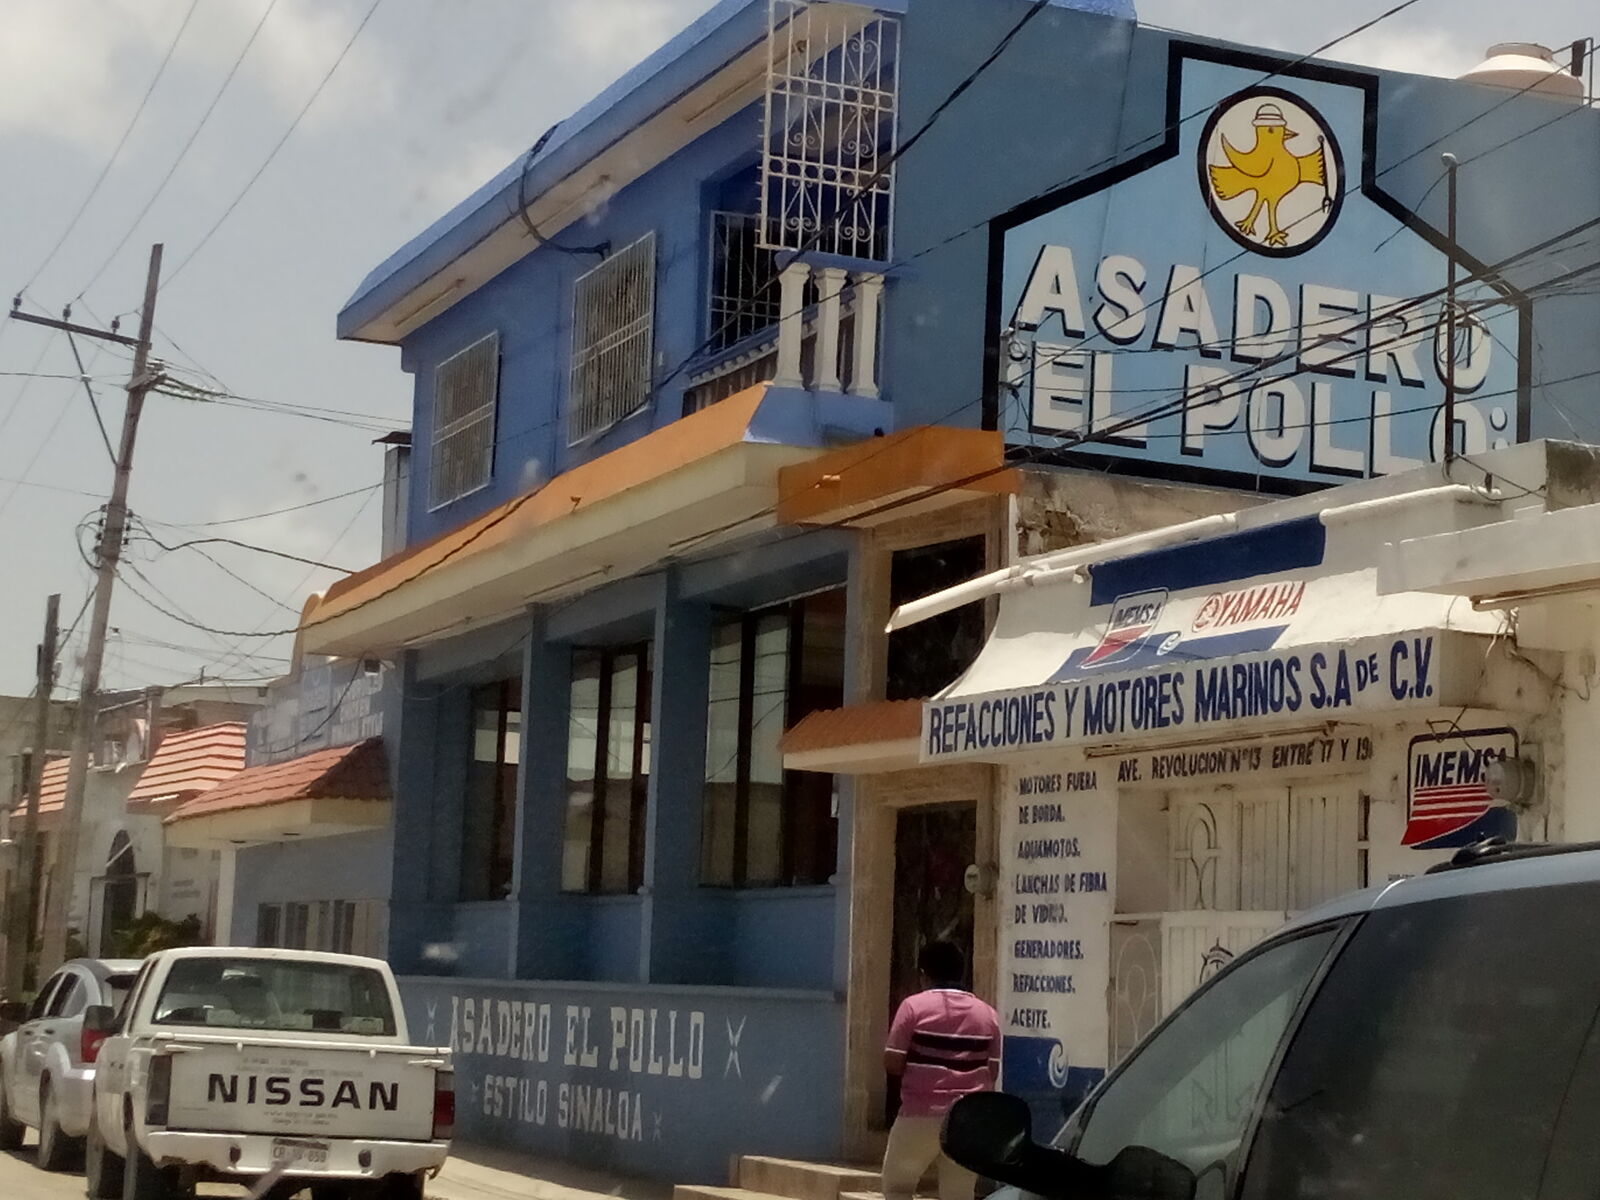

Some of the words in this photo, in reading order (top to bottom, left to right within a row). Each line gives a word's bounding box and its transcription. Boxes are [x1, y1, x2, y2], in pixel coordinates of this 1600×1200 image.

[1009, 244, 1492, 394] ASADERO
[1213, 588, 1306, 628] YAMAHA
[929, 691, 1056, 755] REFACCIONES
[1064, 687, 1080, 738] Y
[1083, 671, 1185, 737] MOTORES
[1194, 655, 1303, 723] MARINOS
[1355, 652, 1380, 692] DE
[1389, 636, 1434, 701] C.V.
[1117, 758, 1142, 783] AVE.
[1151, 749, 1227, 780] REVOLUCION
[1271, 740, 1315, 769] ENTRE
[1341, 738, 1350, 762] Y
[1019, 774, 1062, 795] MOTORES
[1067, 770, 1097, 791] FUERA
[1019, 805, 1029, 824] DE
[1015, 873, 1060, 895] LANCHAS
[1064, 873, 1076, 893] DE
[1079, 871, 1107, 893] FIBRA
[1014, 904, 1027, 924] DE
[1014, 939, 1084, 960] GENERADORES.
[1013, 973, 1076, 994] REFACCIONES.
[1010, 1008, 1051, 1029] ACEITE.
[449, 996, 551, 1063] ASADERO
[563, 1005, 599, 1068] EL
[610, 1006, 704, 1080] POLLO
[207, 1073, 399, 1112] NISSAN
[483, 1074, 548, 1126] ESTILO
[557, 1082, 643, 1142] SINALOA
